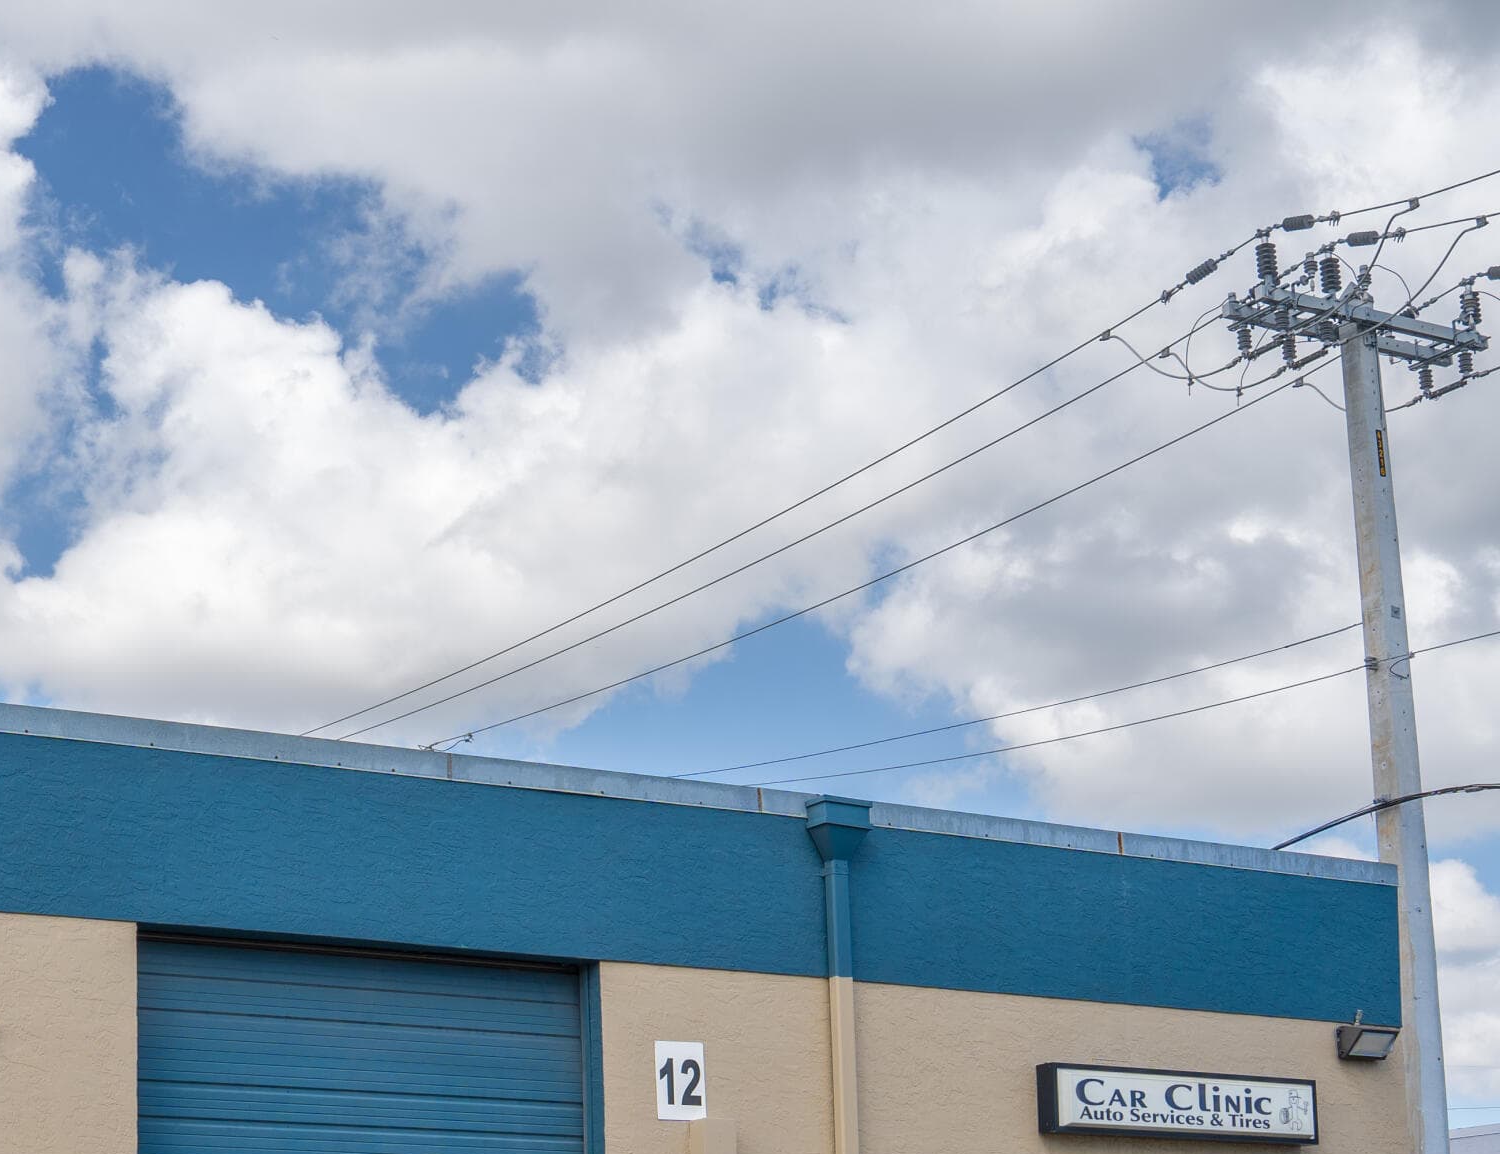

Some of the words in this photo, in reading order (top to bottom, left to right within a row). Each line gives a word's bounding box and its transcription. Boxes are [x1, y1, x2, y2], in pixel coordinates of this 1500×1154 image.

[659, 1058, 702, 1106] 12
[1079, 1105, 1124, 1122] Auto
[1130, 1108, 1204, 1126] Services
[1210, 1113, 1224, 1127] &
[1228, 1113, 1271, 1130] Tires
